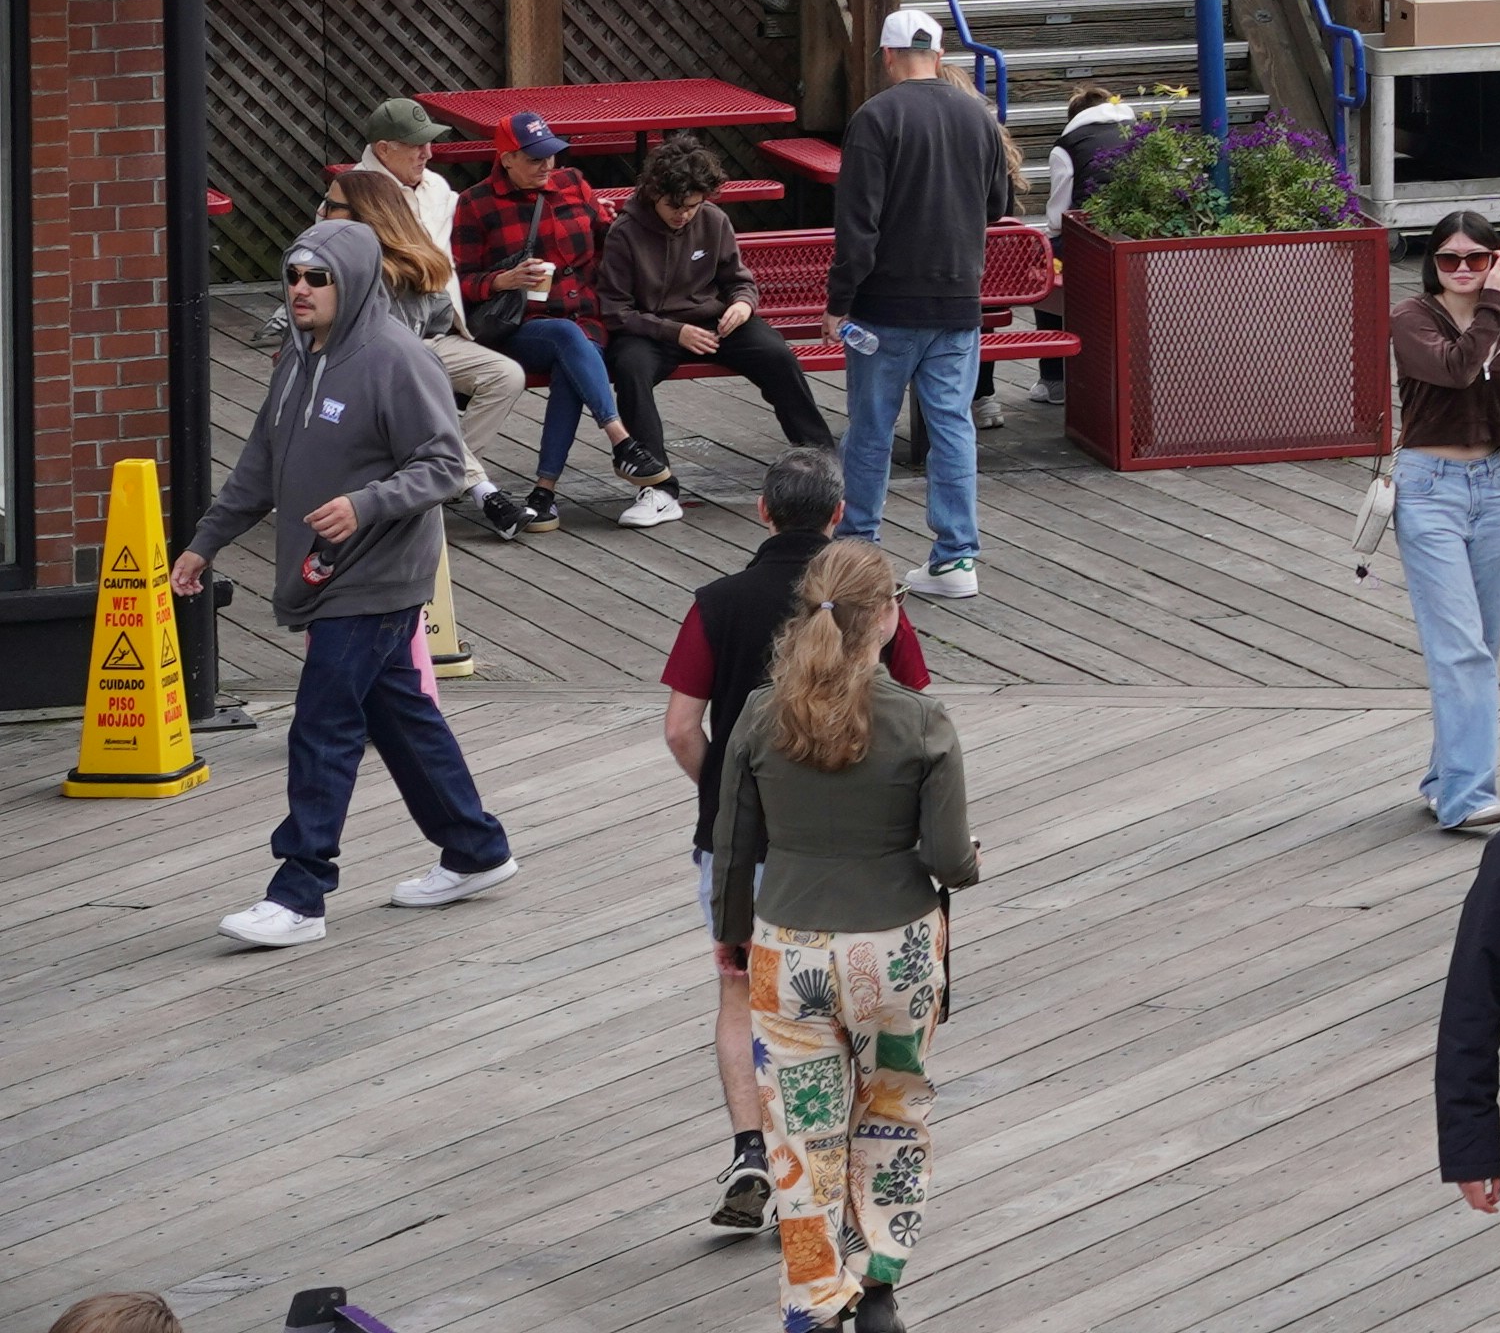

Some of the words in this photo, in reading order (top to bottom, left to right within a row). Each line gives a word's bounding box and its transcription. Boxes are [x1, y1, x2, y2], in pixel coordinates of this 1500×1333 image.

[103, 578, 146, 590] CAUTION
[112, 597, 137, 611] WET
[156, 591, 167, 608] WET
[105, 613, 144, 627] FLOOR
[156, 607, 172, 626] FLOOR
[99, 679, 145, 690] CUIDADO
[108, 697, 135, 711] PISO
[166, 690, 177, 707] PISO
[97, 713, 145, 727] MOJADO
